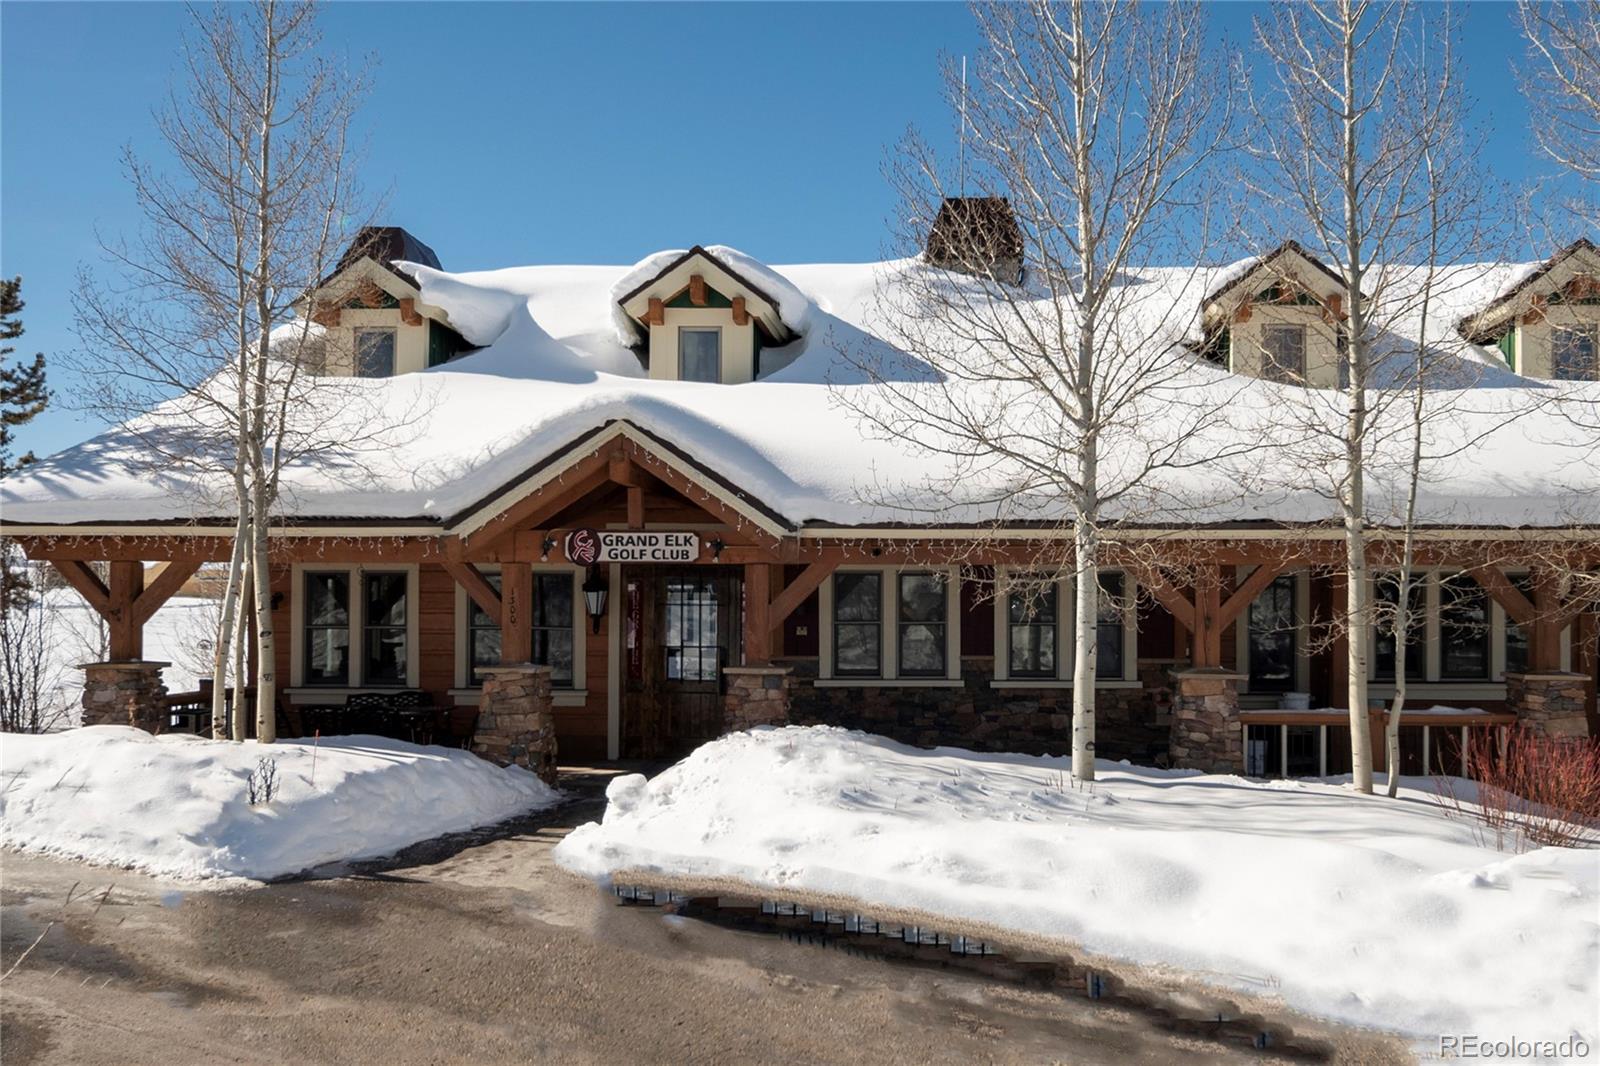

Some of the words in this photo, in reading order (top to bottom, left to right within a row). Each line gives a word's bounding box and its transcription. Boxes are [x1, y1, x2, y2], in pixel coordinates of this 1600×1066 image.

[602, 534, 659, 547] GRAND
[664, 534, 694, 547] ELK
[607, 549, 648, 561] GOLF
[651, 549, 690, 561] CLUB
